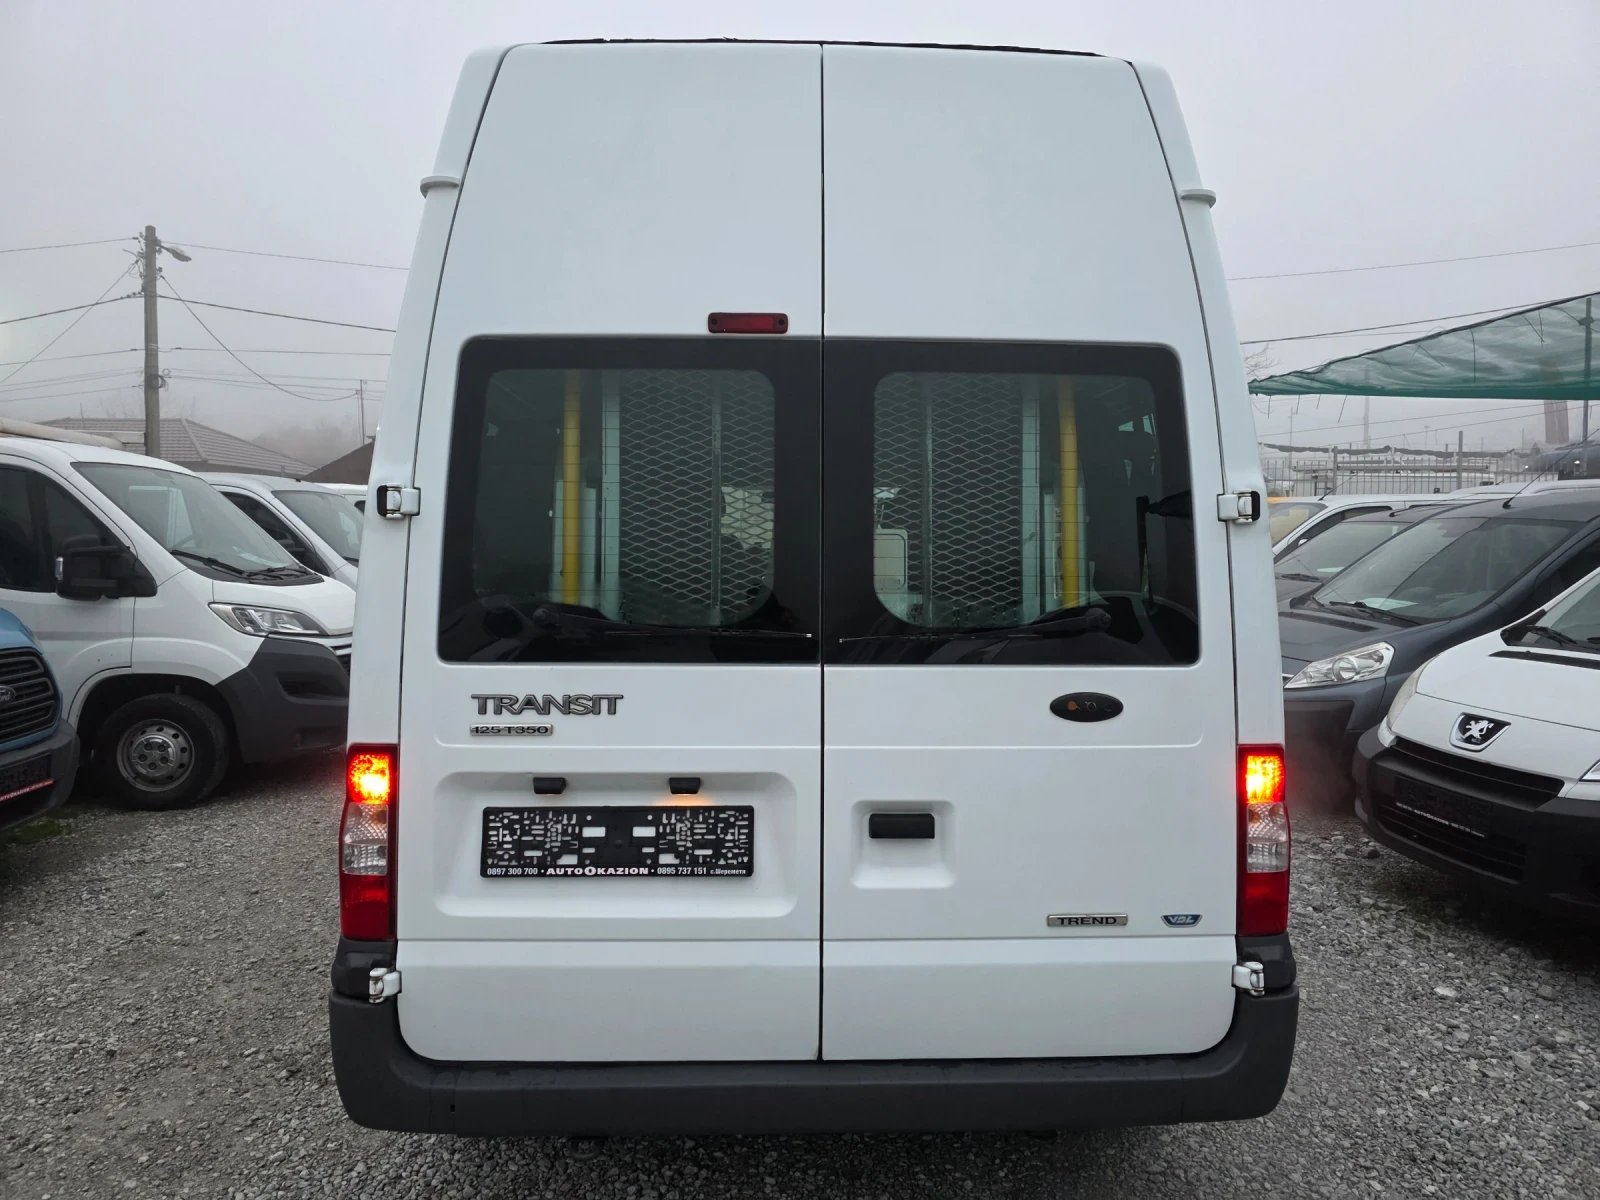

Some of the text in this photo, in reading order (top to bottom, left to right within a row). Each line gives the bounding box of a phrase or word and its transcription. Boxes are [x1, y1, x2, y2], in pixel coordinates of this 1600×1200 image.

[470, 694, 624, 715] TRANSIT
[472, 726, 549, 734] 125 T350
[487, 867, 506, 875] 0897
[507, 867, 522, 875] 300
[524, 867, 538, 875] 700
[546, 866, 649, 876] AUTOOKAZION
[657, 867, 676, 875] 0895
[678, 867, 691, 875] 737
[694, 867, 707, 875] 151
[1057, 917, 1117, 925] TREND
[1167, 916, 1196, 924] VDL
